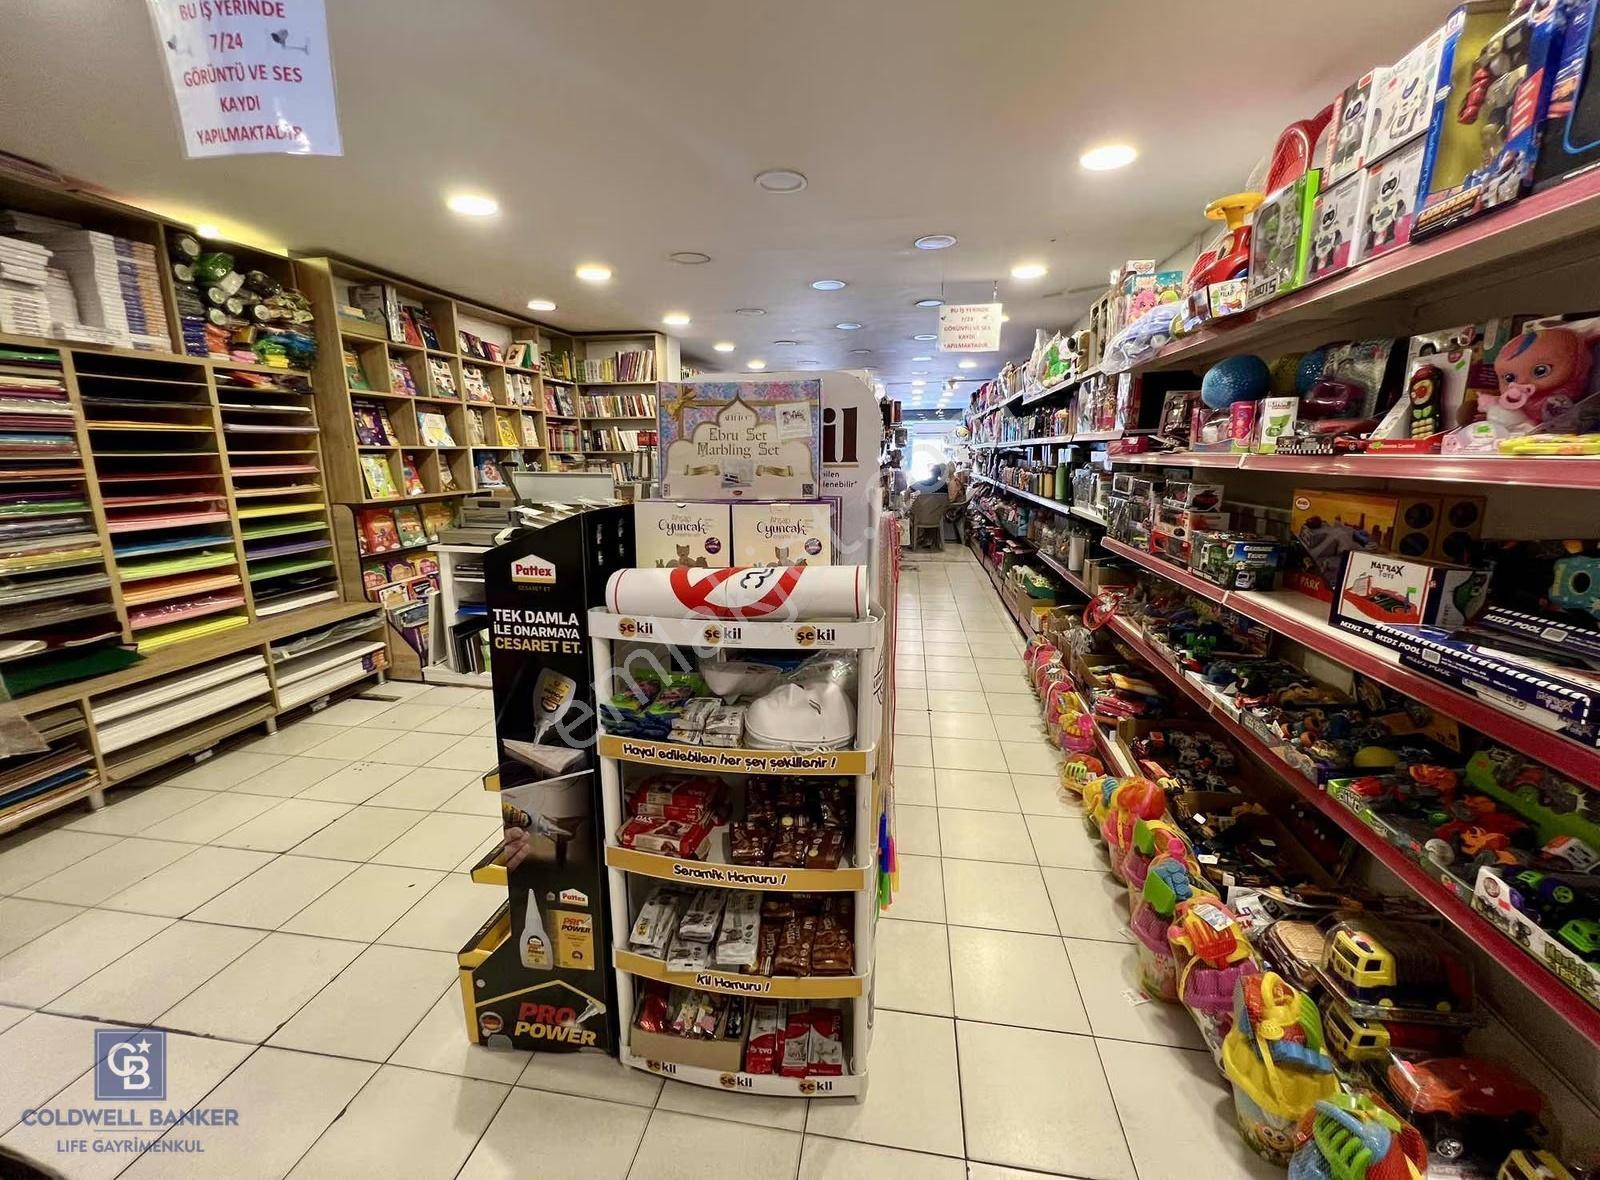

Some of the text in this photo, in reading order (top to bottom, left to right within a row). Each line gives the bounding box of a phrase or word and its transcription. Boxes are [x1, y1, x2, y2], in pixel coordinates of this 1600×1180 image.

[179, 3, 197, 20] BU
[209, 32, 243, 52] 7/24
[184, 61, 302, 87] GÖRÜNTÜ VE SES
[220, 96, 260, 112] KAYDI
[709, 427, 768, 441] Ebru Set
[697, 442, 780, 459] Marbling Set
[515, 564, 552, 577] Pattex
[492, 608, 580, 626] TEK DAMLA
[493, 621, 580, 640] İLE ONARMAYA
[618, 619, 653, 635] şekil
[704, 627, 742, 640] şekil
[796, 627, 836, 642] şekil
[1512, 621, 1542, 634] POOL
[495, 637, 583, 655] CESARET ET.
[1398, 641, 1421, 655] POOL
[623, 744, 655, 758] Hayal
[658, 748, 716, 764] edilebilen
[720, 753, 740, 766] her
[745, 758, 766, 770] şey
[770, 757, 827, 772] şekillenir
[673, 864, 724, 881] Seramik
[728, 870, 778, 886] Hamuru
[561, 924, 591, 934] POWER
[696, 974, 712, 987] Kil
[714, 977, 763, 992] Hamuru
[518, 1002, 577, 1025] PRO
[514, 1021, 597, 1046] POWER
